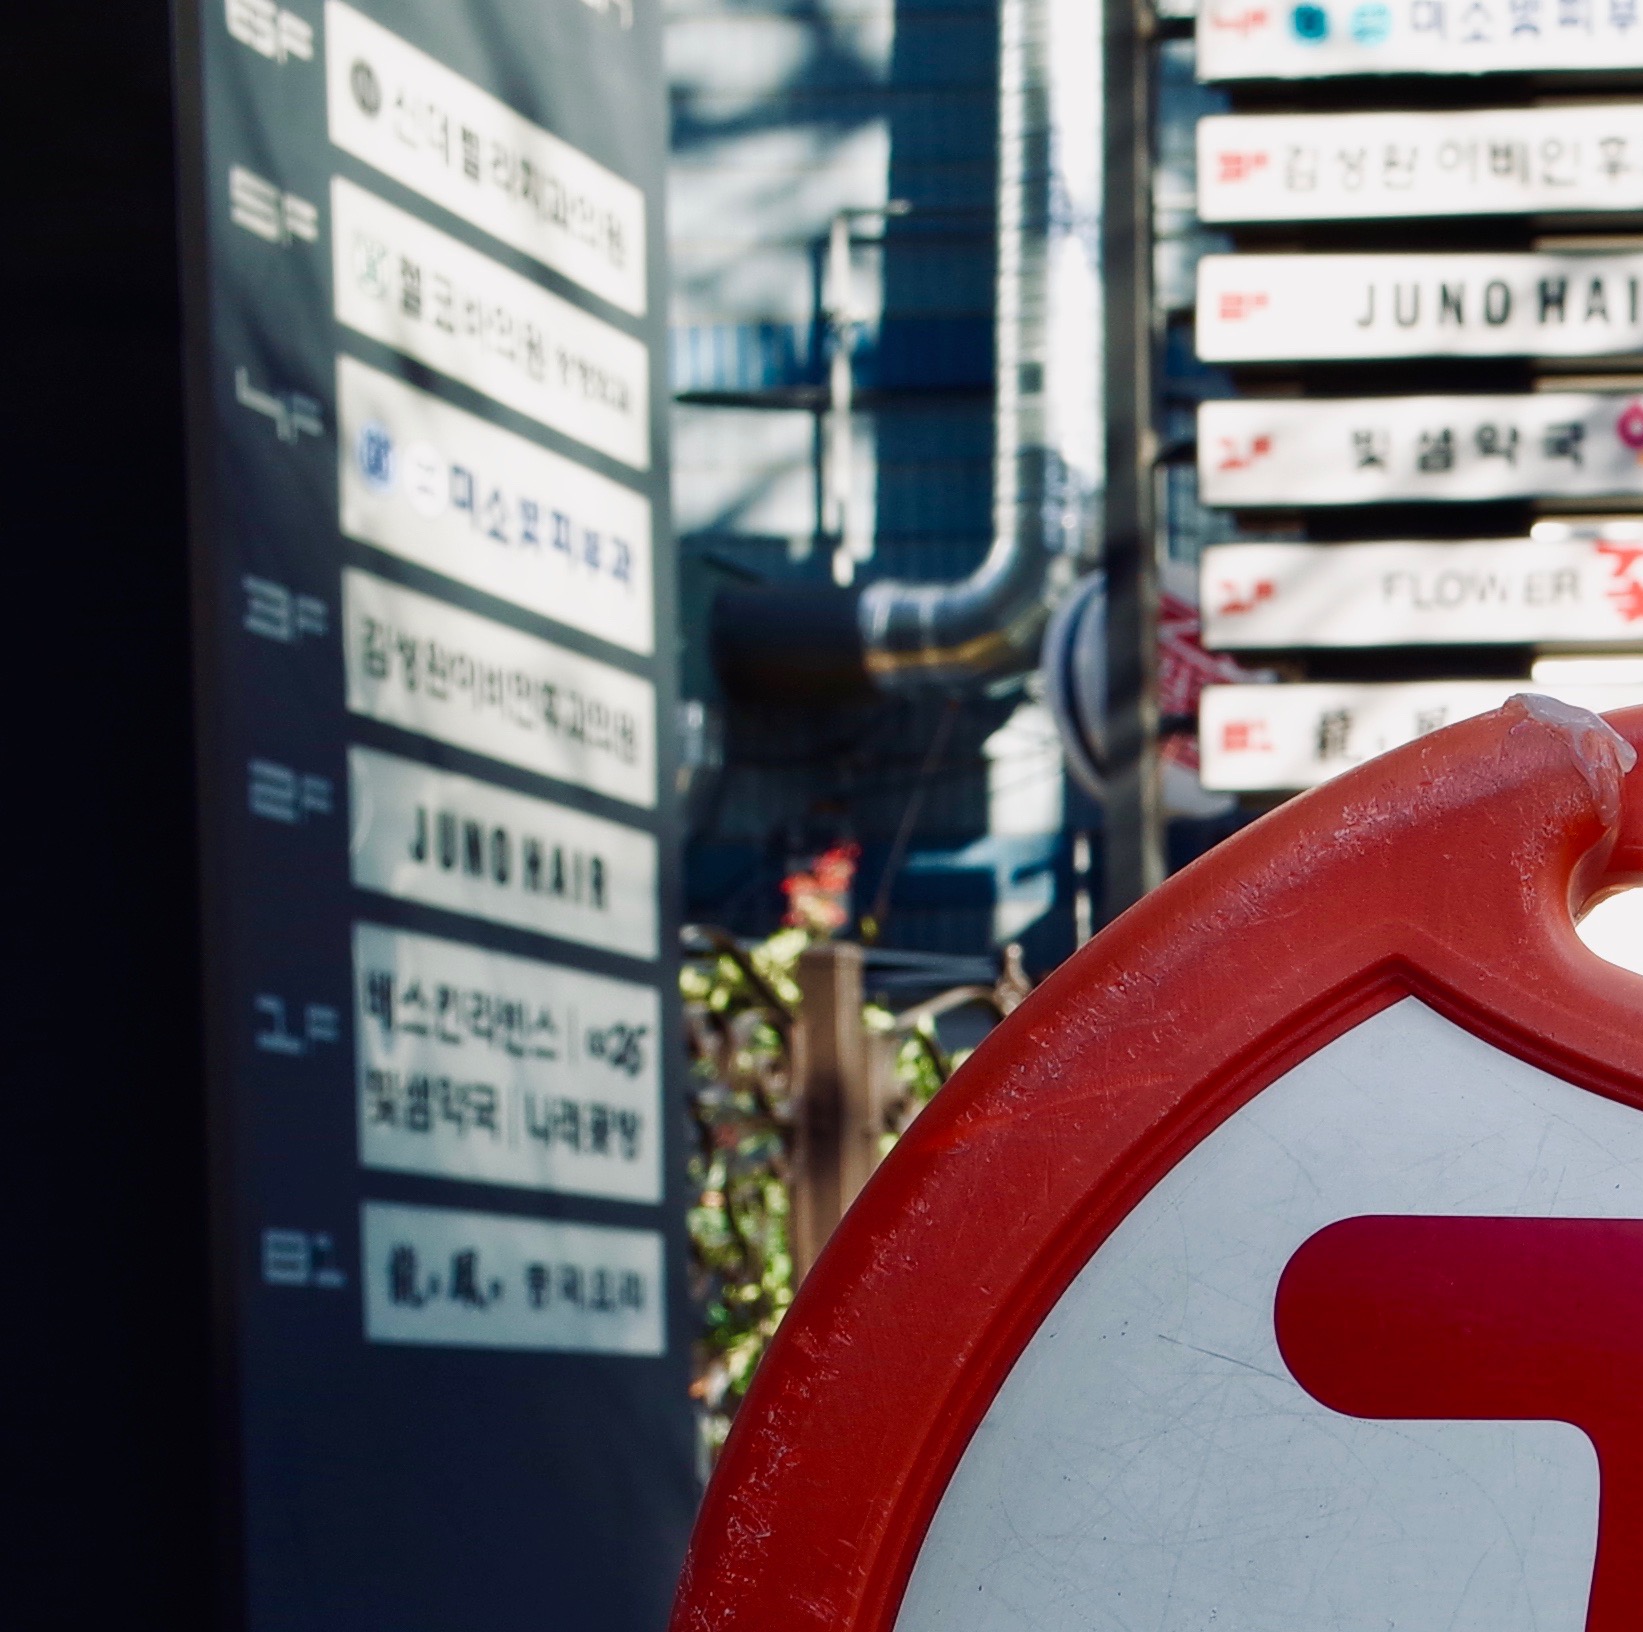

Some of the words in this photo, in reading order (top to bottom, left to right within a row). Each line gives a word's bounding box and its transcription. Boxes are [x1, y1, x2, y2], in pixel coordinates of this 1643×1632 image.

[1355, 277, 1515, 329] JUNO
[408, 804, 510, 888] JUNO
[523, 836, 612, 910] HAIR
